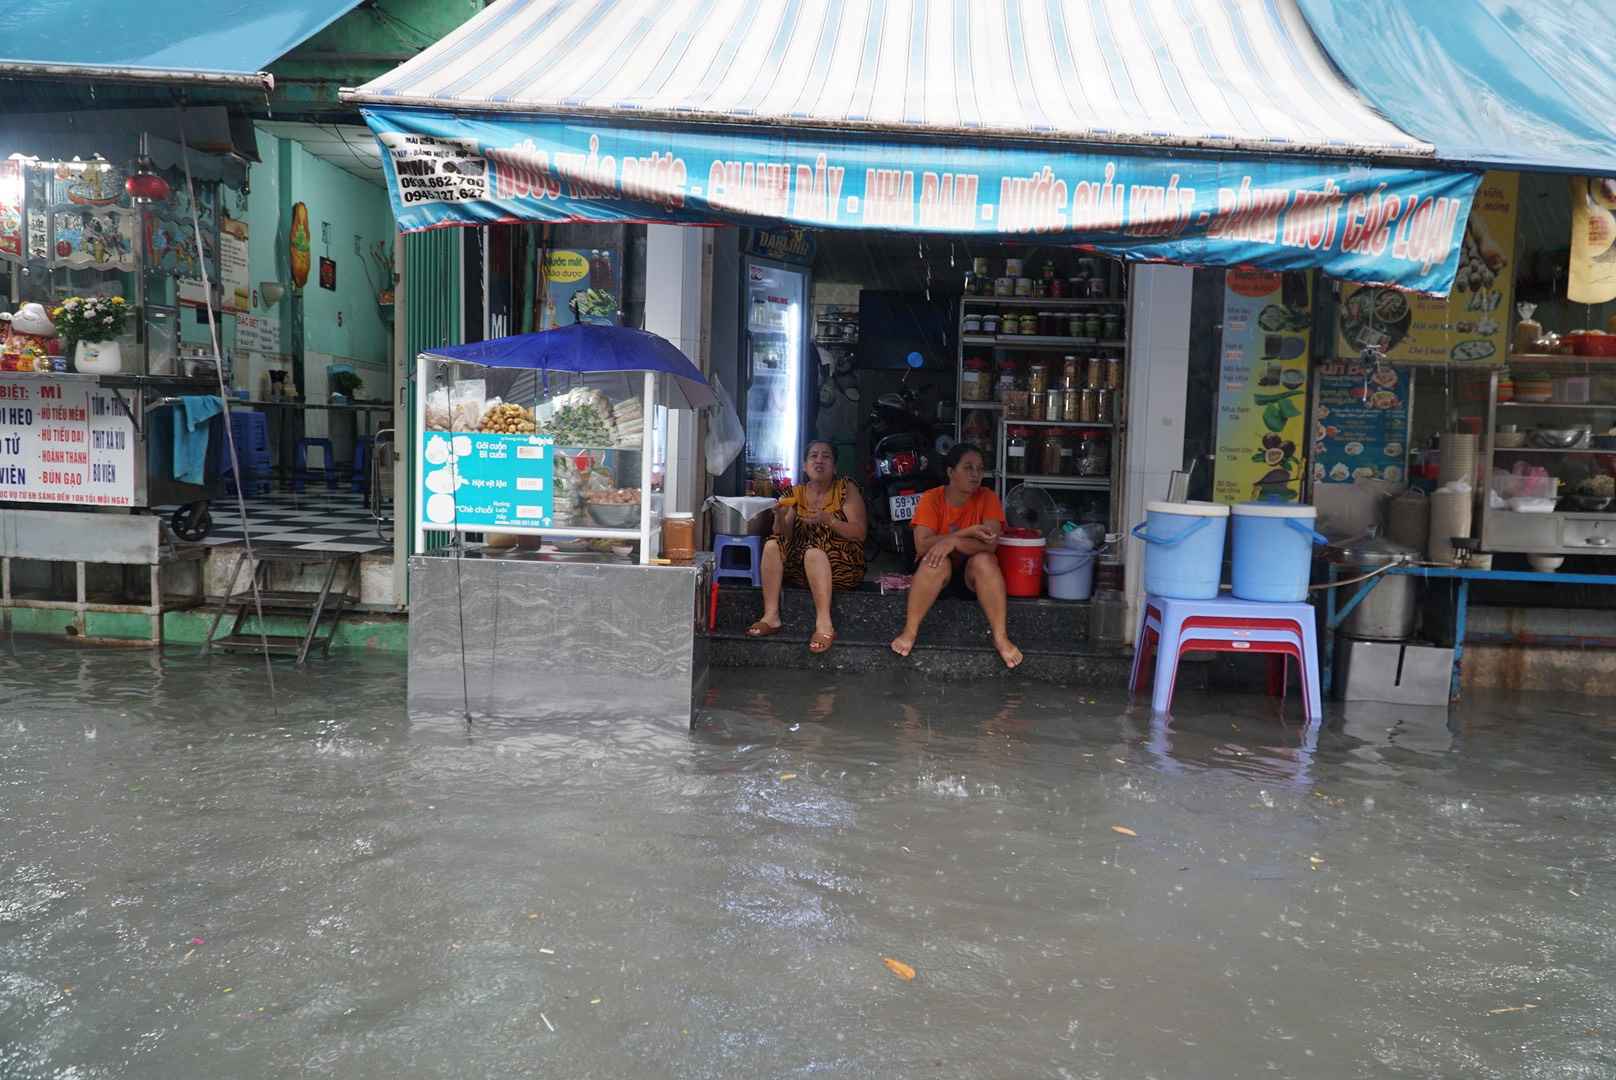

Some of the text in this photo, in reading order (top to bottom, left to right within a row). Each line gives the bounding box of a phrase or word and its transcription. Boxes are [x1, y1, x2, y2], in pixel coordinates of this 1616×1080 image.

[706, 160, 790, 219] CHANH
[864, 168, 914, 226] NHA
[998, 165, 1068, 233] NƯỚC
[1072, 161, 1124, 233] GIẢI
[1125, 174, 1196, 238] KHÁT
[1207, 176, 1280, 244] BÁNH
[1282, 179, 1346, 250] MỨT
[1341, 182, 1400, 256] CÁC
[1391, 195, 1461, 276] LOẠI
[9, 408, 33, 426] HEO
